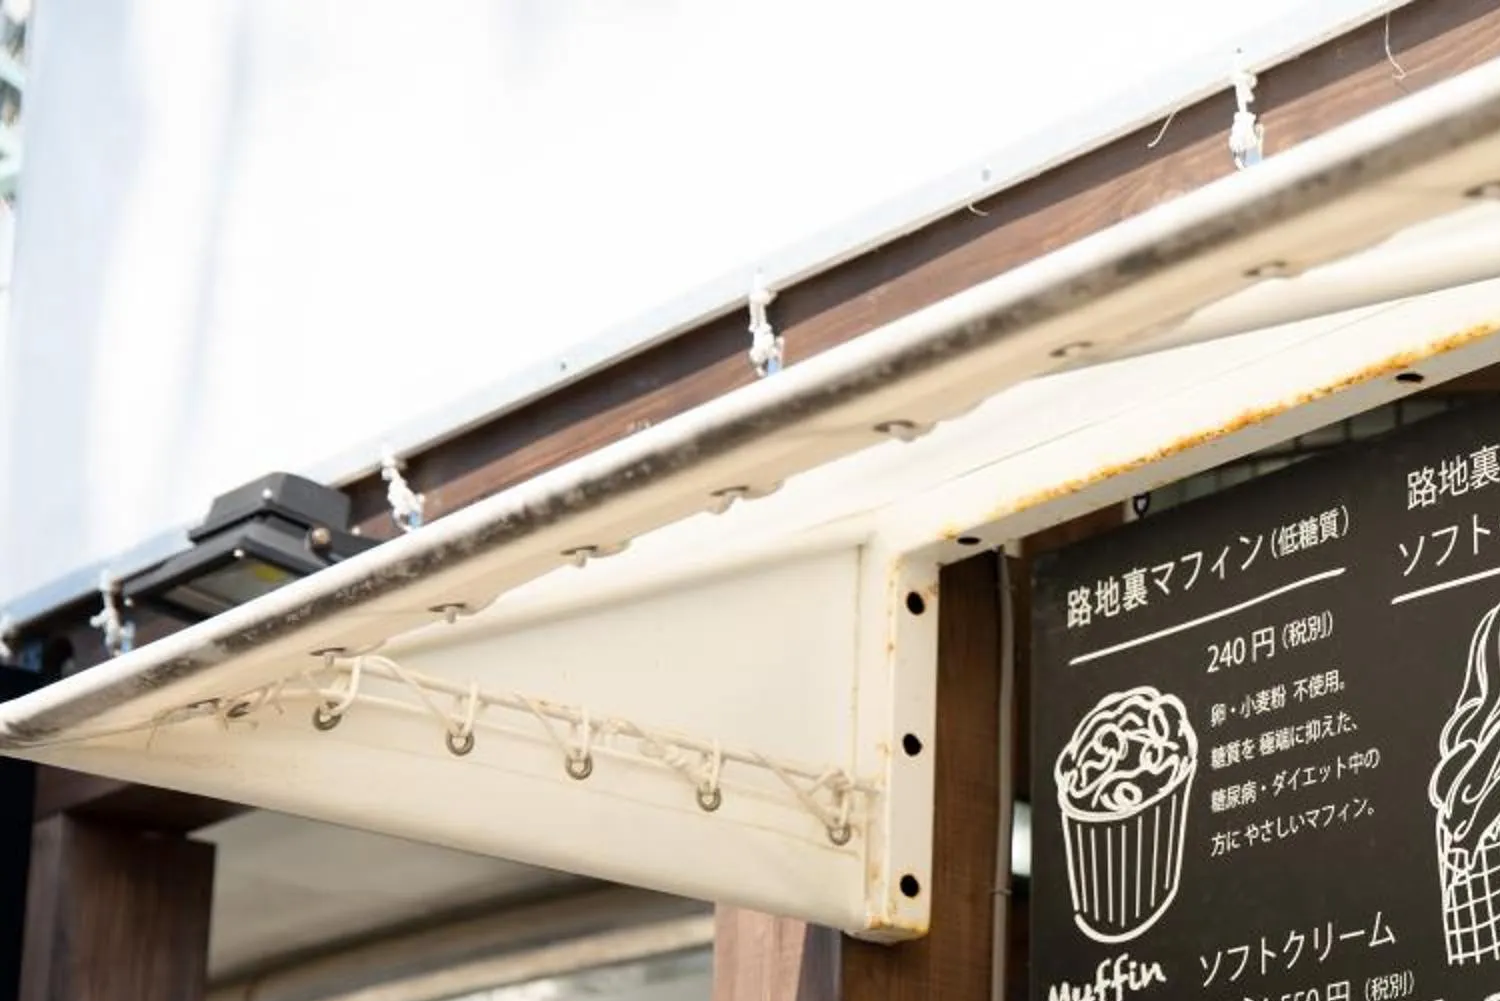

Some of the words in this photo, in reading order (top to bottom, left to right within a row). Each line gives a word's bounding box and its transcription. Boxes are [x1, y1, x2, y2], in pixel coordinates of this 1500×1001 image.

[1407, 444, 1500, 511] 路地裏
[1200, 911, 1396, 988] ソフトクリーム
